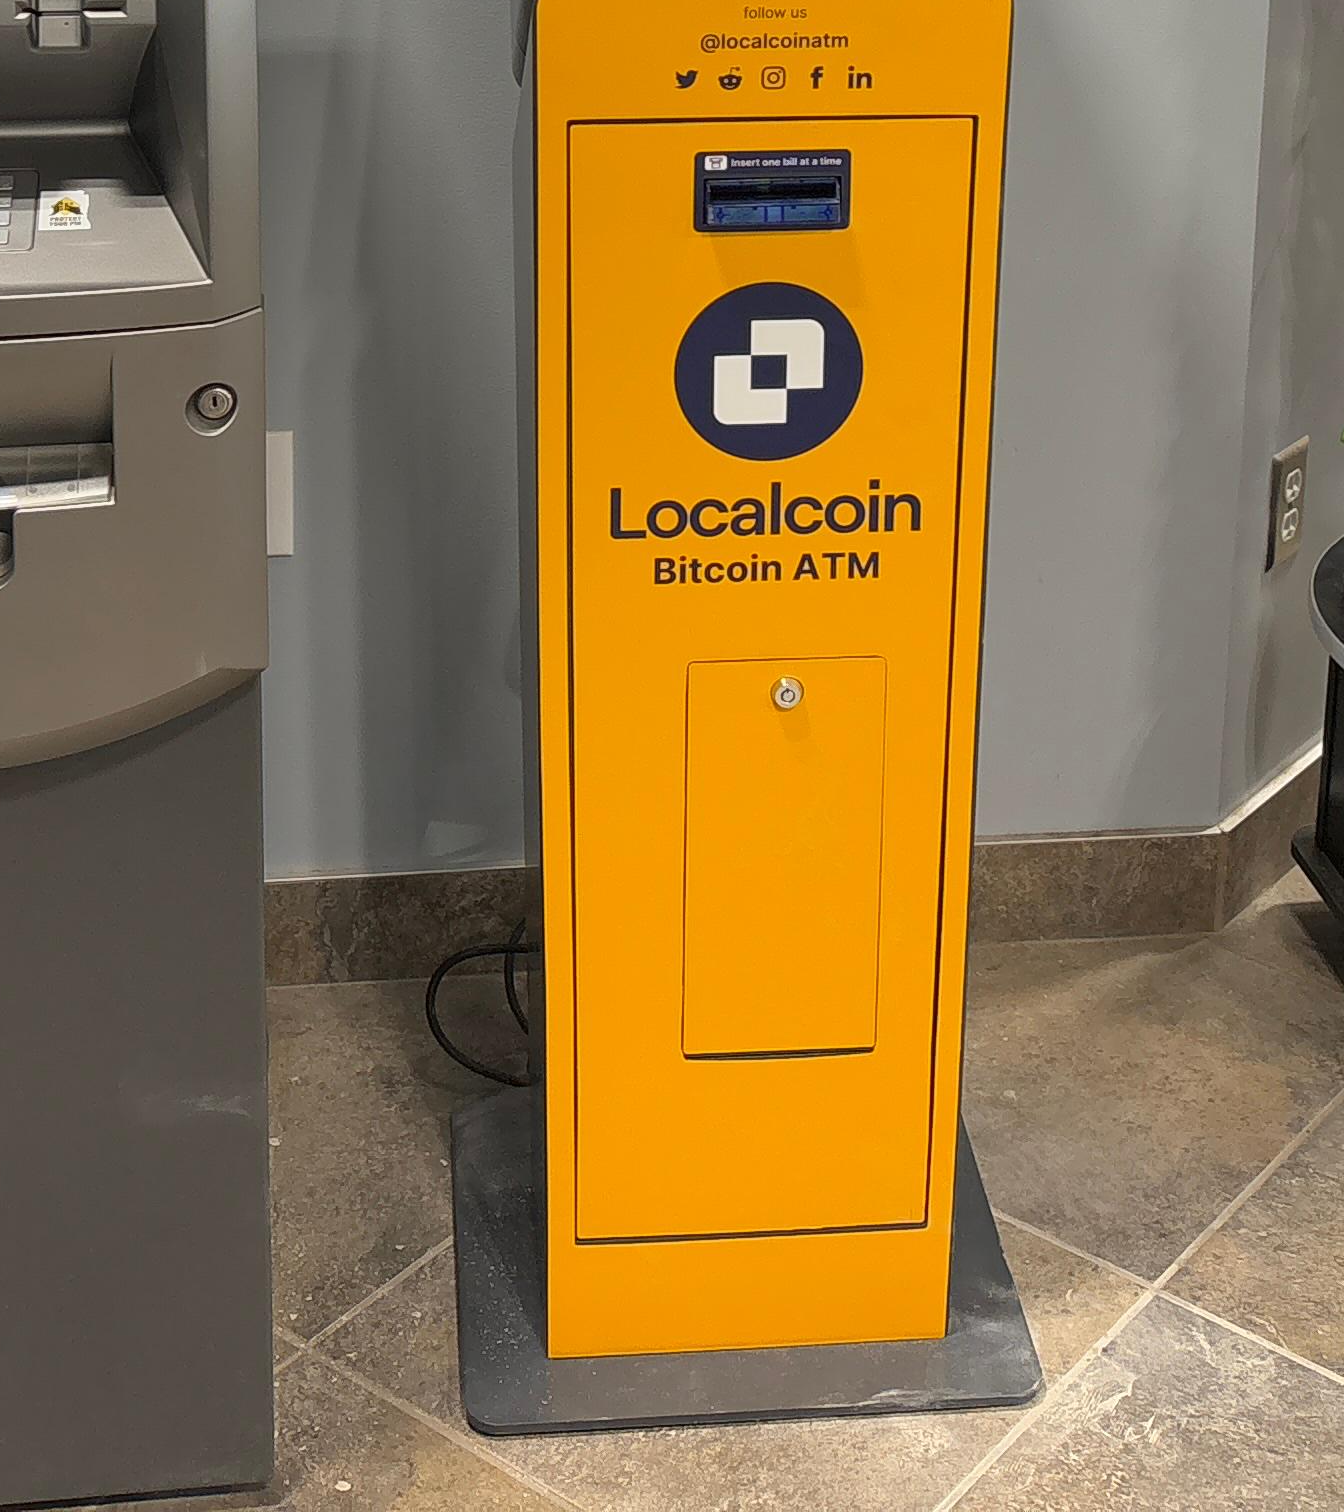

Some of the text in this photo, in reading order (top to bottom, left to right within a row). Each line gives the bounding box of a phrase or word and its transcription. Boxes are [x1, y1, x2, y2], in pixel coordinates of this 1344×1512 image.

[744, 6, 807, 19] follow us
[700, 32, 849, 54] @localcoinatm
[730, 156, 842, 167] Insert one bill at a time
[609, 478, 923, 541] Localcoin
[652, 551, 882, 586] Bitcoin ATM
